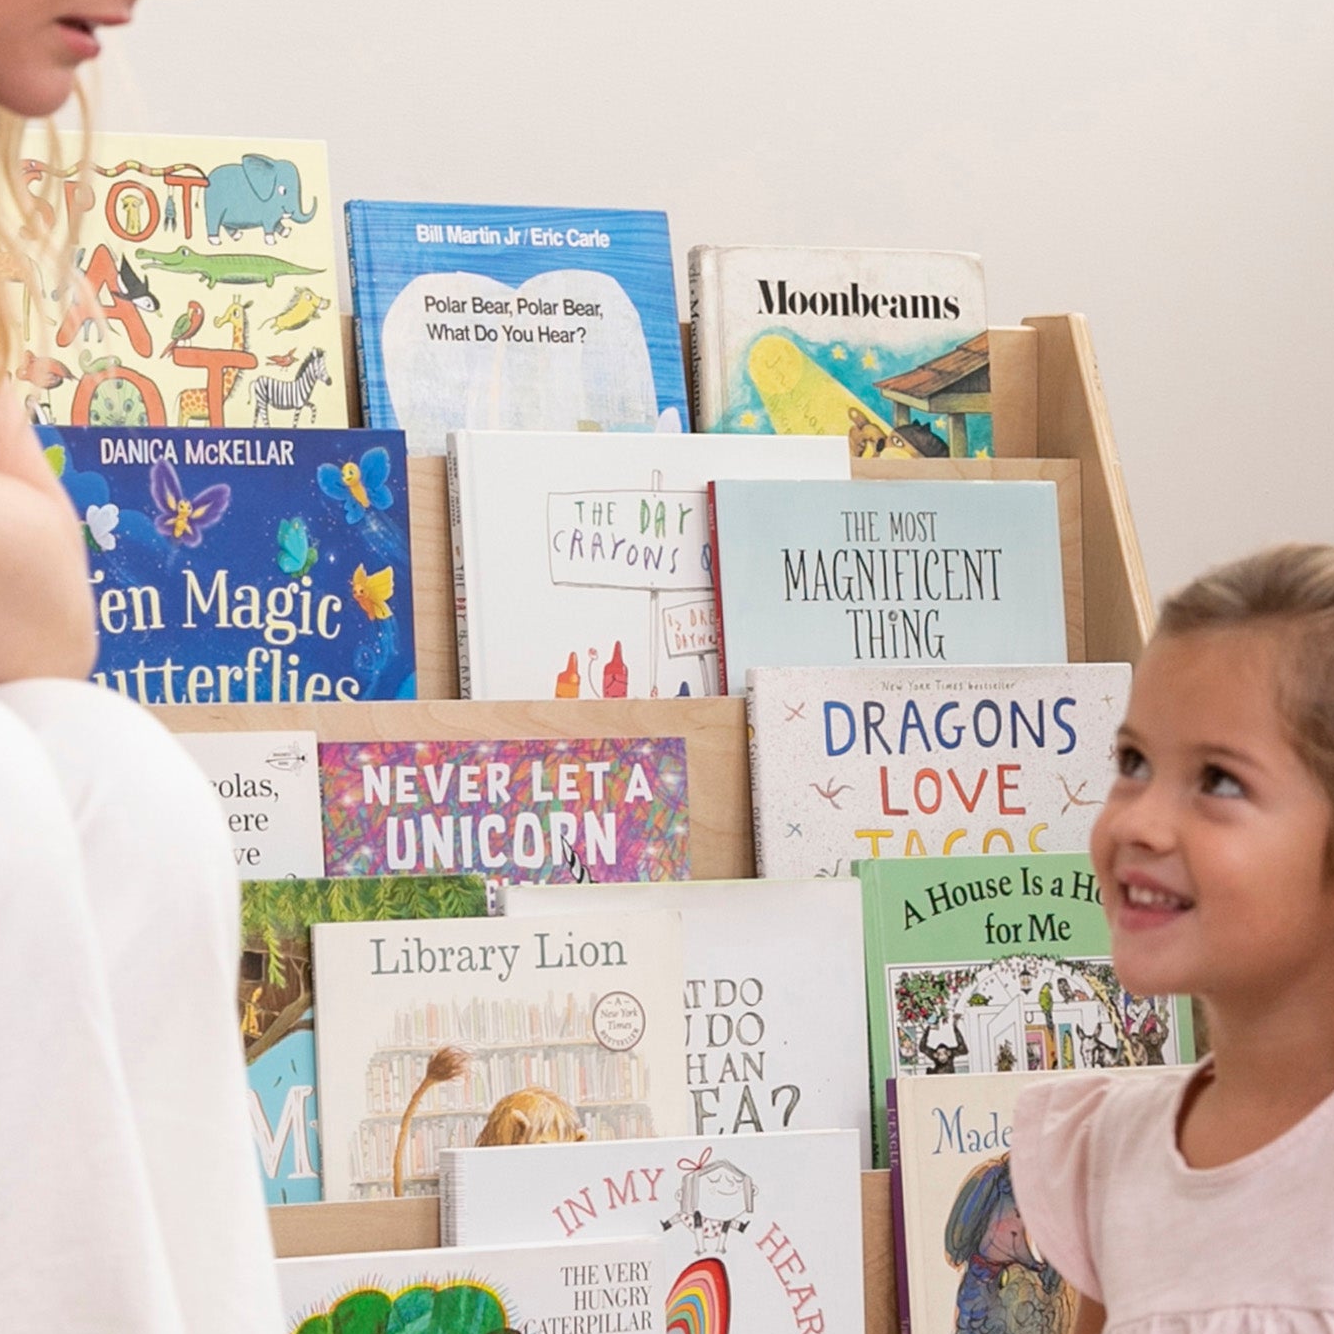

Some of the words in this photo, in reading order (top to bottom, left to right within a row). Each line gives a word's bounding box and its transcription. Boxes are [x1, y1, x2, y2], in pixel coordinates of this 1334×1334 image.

[417, 224, 443, 243] Bill
[447, 225, 501, 245] Martin
[504, 227, 522, 246] Jr
[531, 228, 564, 247] Eric
[566, 228, 610, 248] Carle
[425, 296, 466, 314] Polar
[473, 297, 513, 317] Bear,
[517, 298, 559, 316] Polar
[563, 299, 604, 320] Bear,
[757, 279, 960, 320] Moonbeams
[426, 323, 470, 341] What
[474, 324, 498, 342] Do
[501, 325, 533, 343] You
[539, 326, 587, 344] Hear?
[101, 438, 178, 465] DANICA
[186, 439, 294, 466] McKELLAR
[574, 501, 617, 526] THE
[640, 499, 693, 538] DAY
[841, 512, 880, 542] THE
[889, 511, 937, 542] MOST
[553, 528, 679, 574] CRAYONS
[781, 549, 1002, 603] MAGNIFICENT
[181, 569, 343, 645] Magic
[823, 697, 1077, 757] DRAGONS
[362, 762, 511, 804] NEVER
[531, 761, 610, 802] LET
[624, 764, 654, 802] A
[880, 764, 1026, 816] LOVE
[228, 813, 269, 832] ere
[386, 812, 617, 870] UNICORN
[903, 900, 926, 931] A
[925, 876, 1013, 916] House
[1020, 867, 1043, 896] Is
[1050, 877, 1063, 897] a
[985, 913, 1023, 944] for
[1028, 913, 1072, 942] Me
[370, 937, 520, 982] Library
[533, 931, 627, 970] Lion
[714, 977, 764, 1008] DO
[705, 1011, 765, 1048] DO
[718, 1051, 765, 1083] AN
[690, 1084, 801, 1135] EA?
[932, 1105, 1013, 1155] Made
[552, 1186, 597, 1238] IN
[603, 1168, 665, 1210] MY
[560, 1266, 600, 1287] THE
[605, 1261, 652, 1283] VERY
[573, 1286, 652, 1311] HUNGRY
